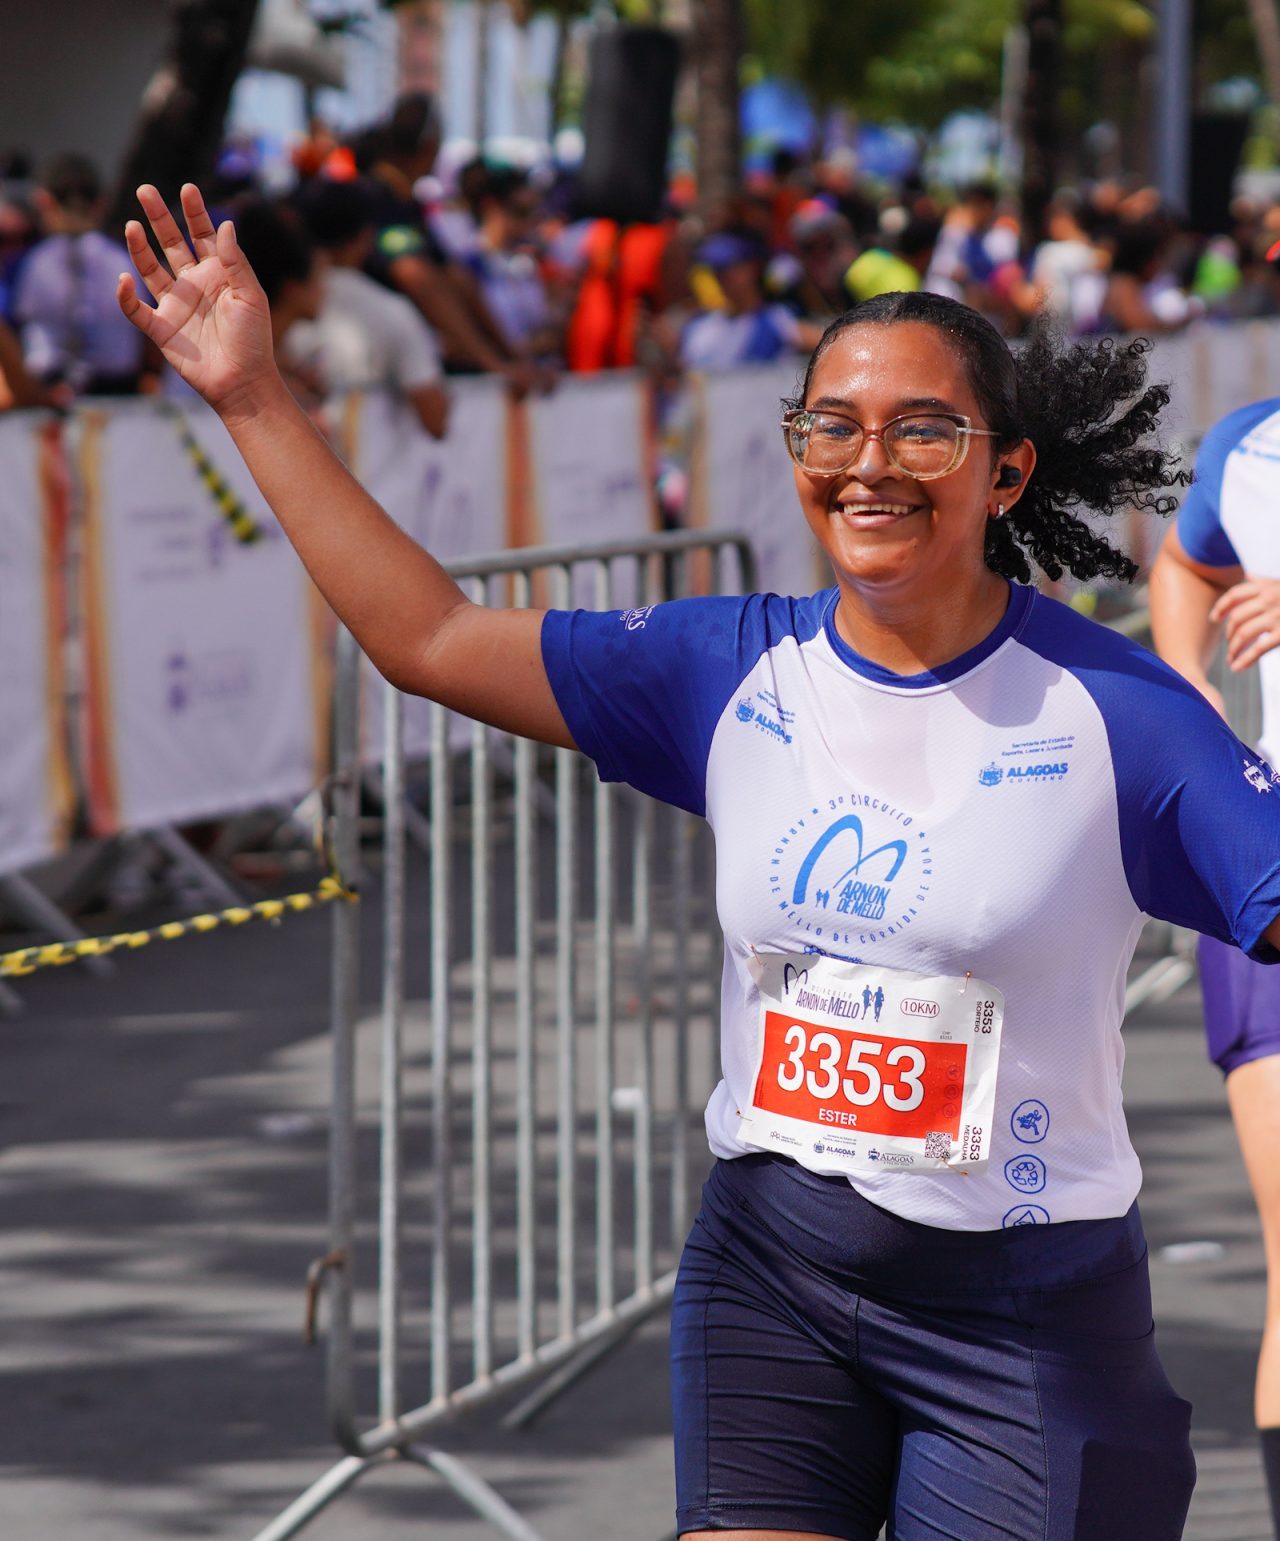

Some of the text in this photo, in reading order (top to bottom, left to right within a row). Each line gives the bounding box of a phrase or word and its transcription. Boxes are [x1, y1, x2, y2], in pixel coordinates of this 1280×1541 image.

[1007, 762, 1068, 777] ALAGOAS
[851, 794, 913, 827] CIRCUITO
[770, 819, 933, 944] ARNON DE MELLO DE CORRIDA DE RUA
[839, 879, 891, 906] ARNON
[837, 898, 886, 920] DE MELLO
[795, 988, 860, 1019] ARNON DE MELLO
[903, 1001, 937, 1015] 10KM
[974, 1001, 982, 1033] SORTEIO
[981, 1001, 995, 1034] 3353
[777, 1024, 927, 1112] 3353
[818, 1108, 858, 1126] ESTER
[826, 1145, 856, 1156] ALAGOAS
[880, 1153, 914, 1163] ALAGOAS
[961, 1125, 970, 1161] MEDALHA
[969, 1126, 983, 1161] 3353
